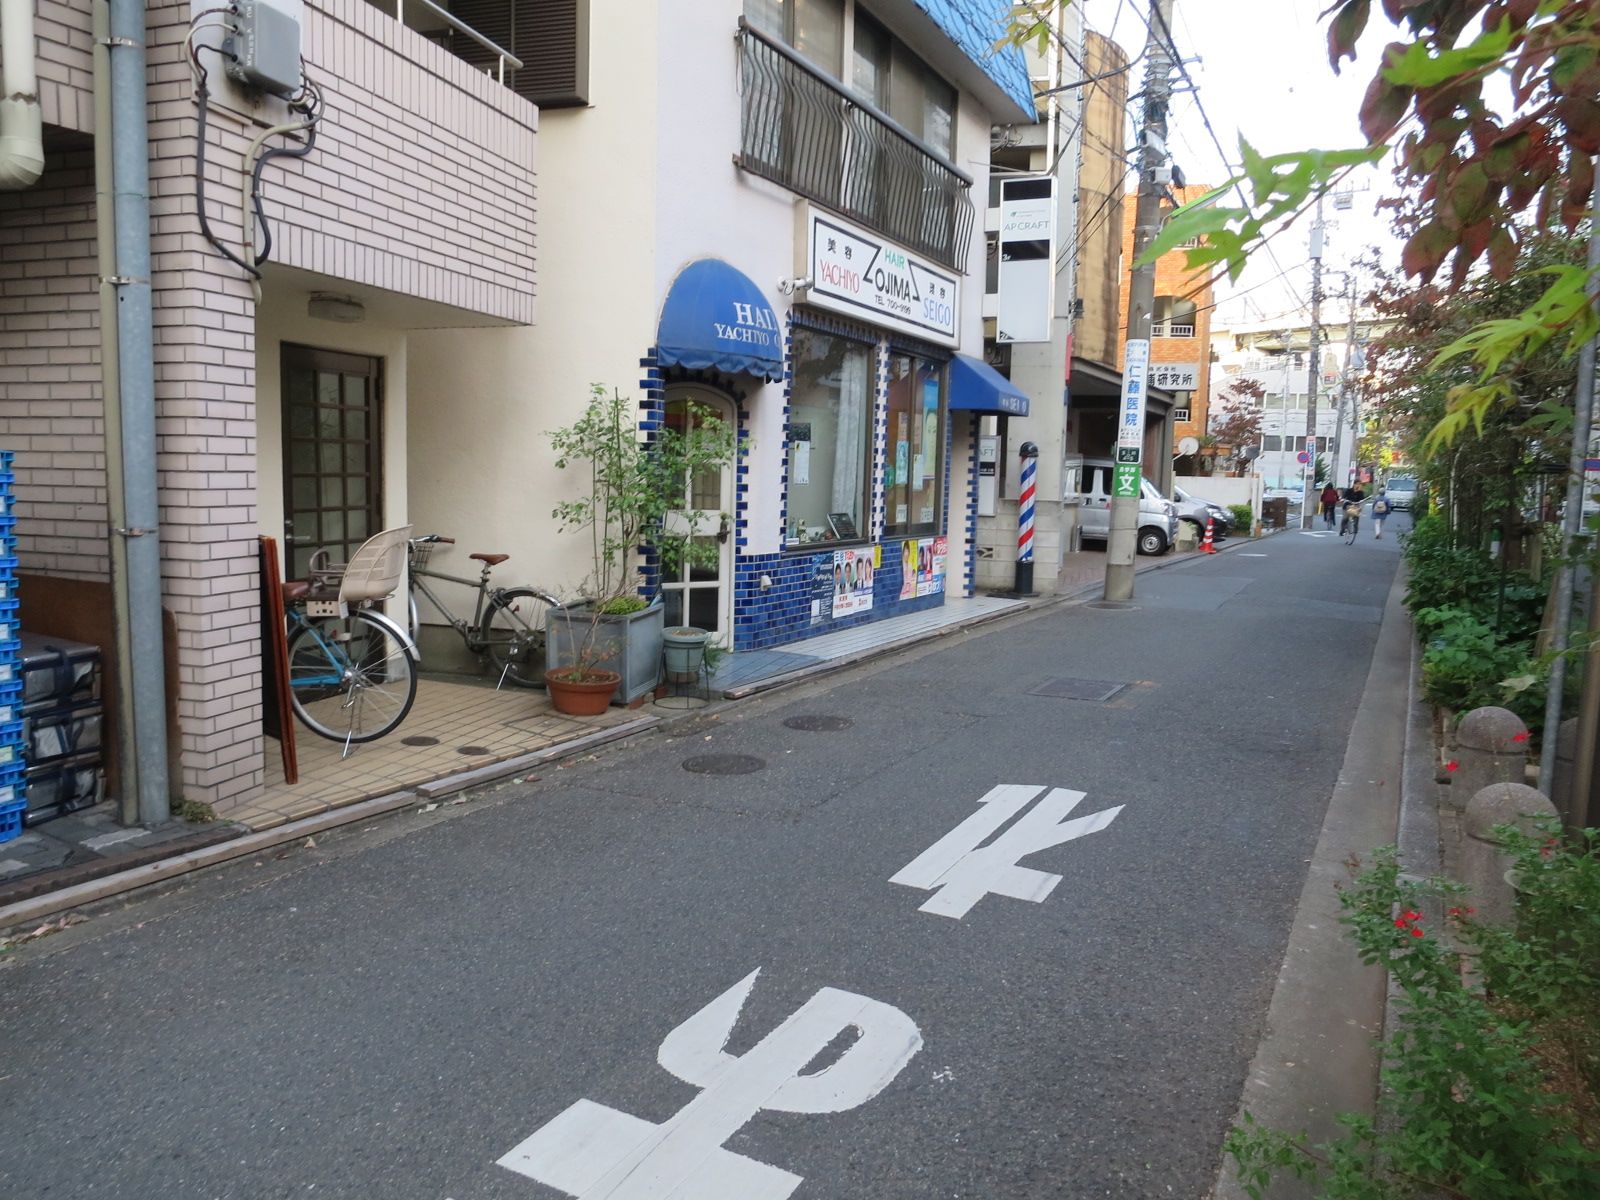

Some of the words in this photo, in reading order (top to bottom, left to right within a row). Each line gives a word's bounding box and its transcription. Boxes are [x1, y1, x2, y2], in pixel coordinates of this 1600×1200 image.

[885, 249, 905, 269] HAIR
[819, 259, 861, 295] YACHIYO
[874, 267, 912, 303] OJIMA
[874, 293, 886, 307] TEL
[714, 323, 769, 345] YACHIYO
